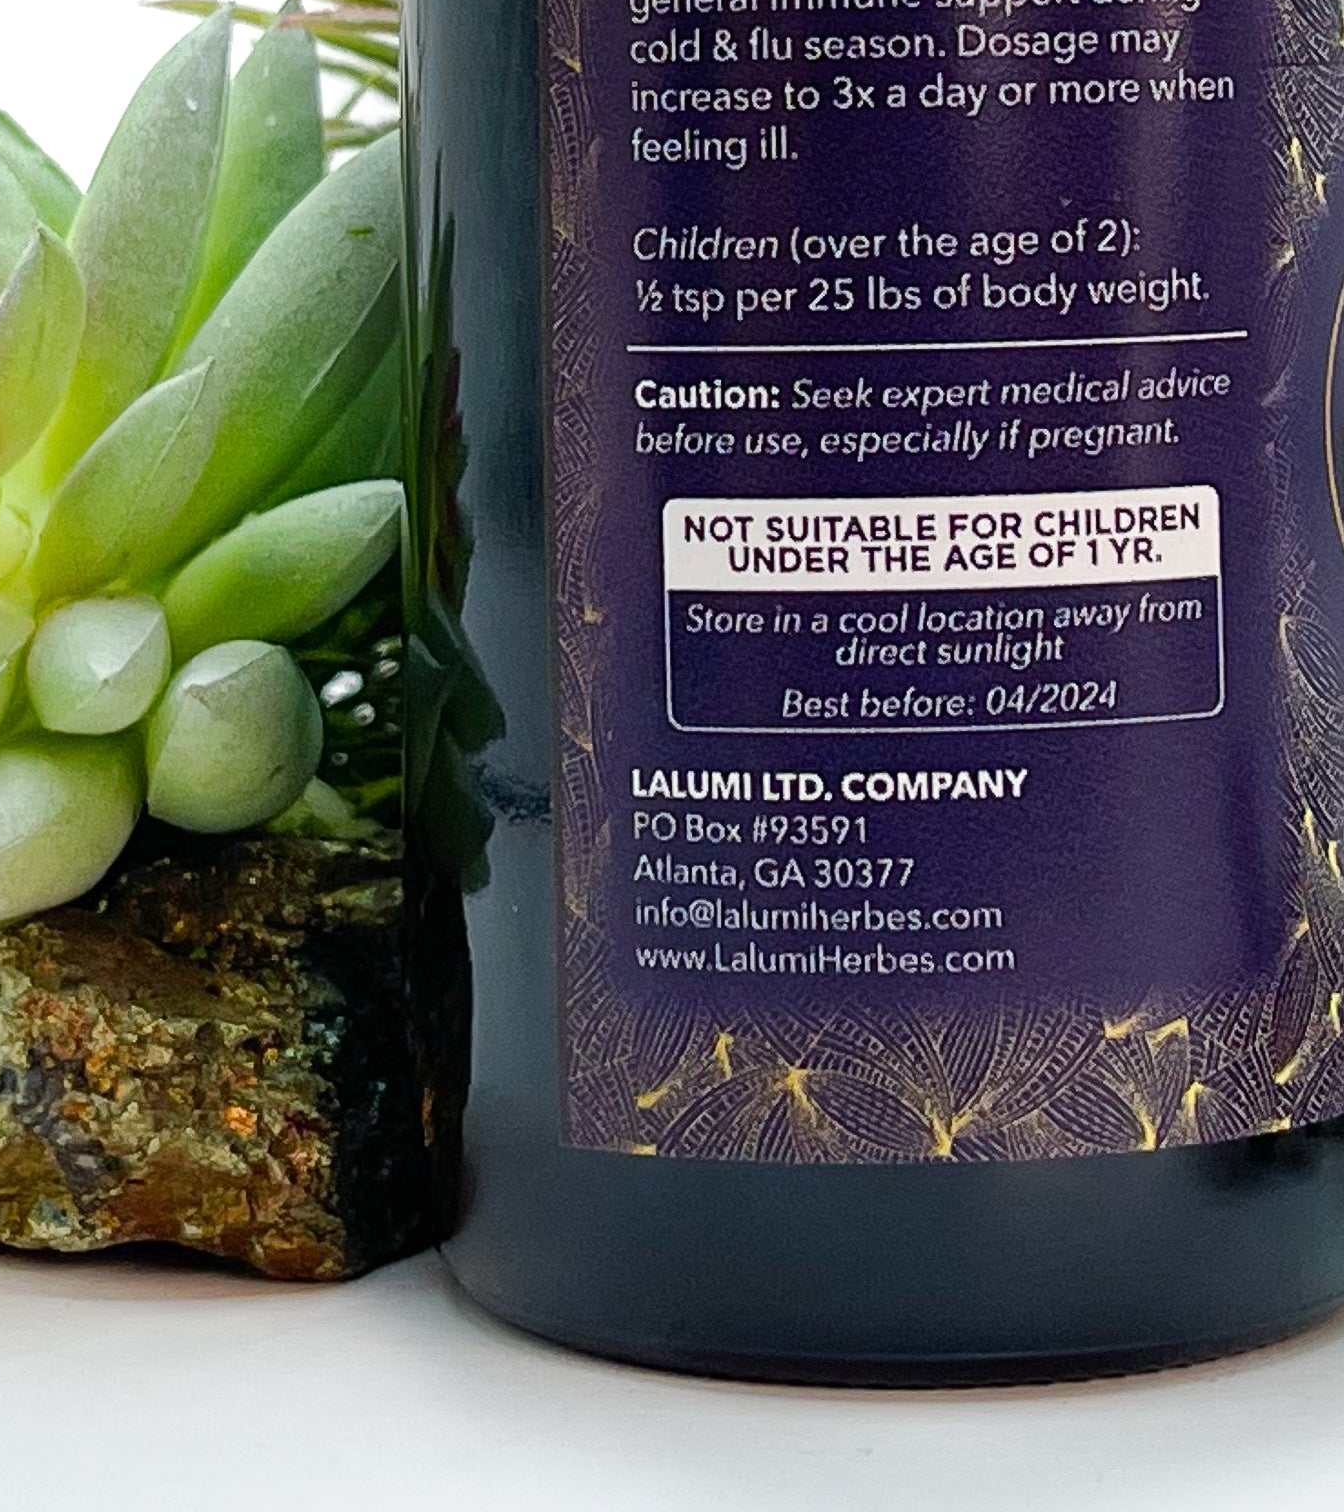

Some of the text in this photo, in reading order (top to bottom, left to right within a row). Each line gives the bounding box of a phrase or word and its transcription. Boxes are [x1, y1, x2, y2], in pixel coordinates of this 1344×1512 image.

[630, 24, 1180, 64] cold & flu season. Dosage may
[631, 67, 1234, 117] increase to 3x a day or more when
[631, 125, 798, 171] feeling ill.
[633, 217, 1140, 265] Children (over the age of 2):
[672, 283, 725, 322] tsp
[736, 288, 798, 321] per
[808, 277, 855, 311] 25
[868, 275, 922, 310] lbs
[933, 272, 971, 310] of
[982, 272, 1078, 315] body
[1087, 267, 1209, 312] weight.
[635, 366, 1231, 416] Caution: Seek expert medical advice
[635, 418, 1179, 463] before use, especially if pregnant.
[684, 503, 1200, 543] NOT SUITABLE FOR CHILDREN
[728, 537, 1162, 574] UNDER THE AGE OF 1 YR.
[686, 592, 1202, 634] Store in a cool location away from
[835, 631, 1064, 670] direct sunlight
[782, 680, 1117, 718] Best before: 04/2024
[632, 768, 1028, 801] LALUMI LTD. COMPANY
[633, 811, 866, 845] PO Box #93591
[633, 854, 914, 891] Atlanta, GA 30377
[636, 896, 1002, 931] info@lalumiherbes.com
[635, 941, 1015, 974] www.LalumiHerbes.com
